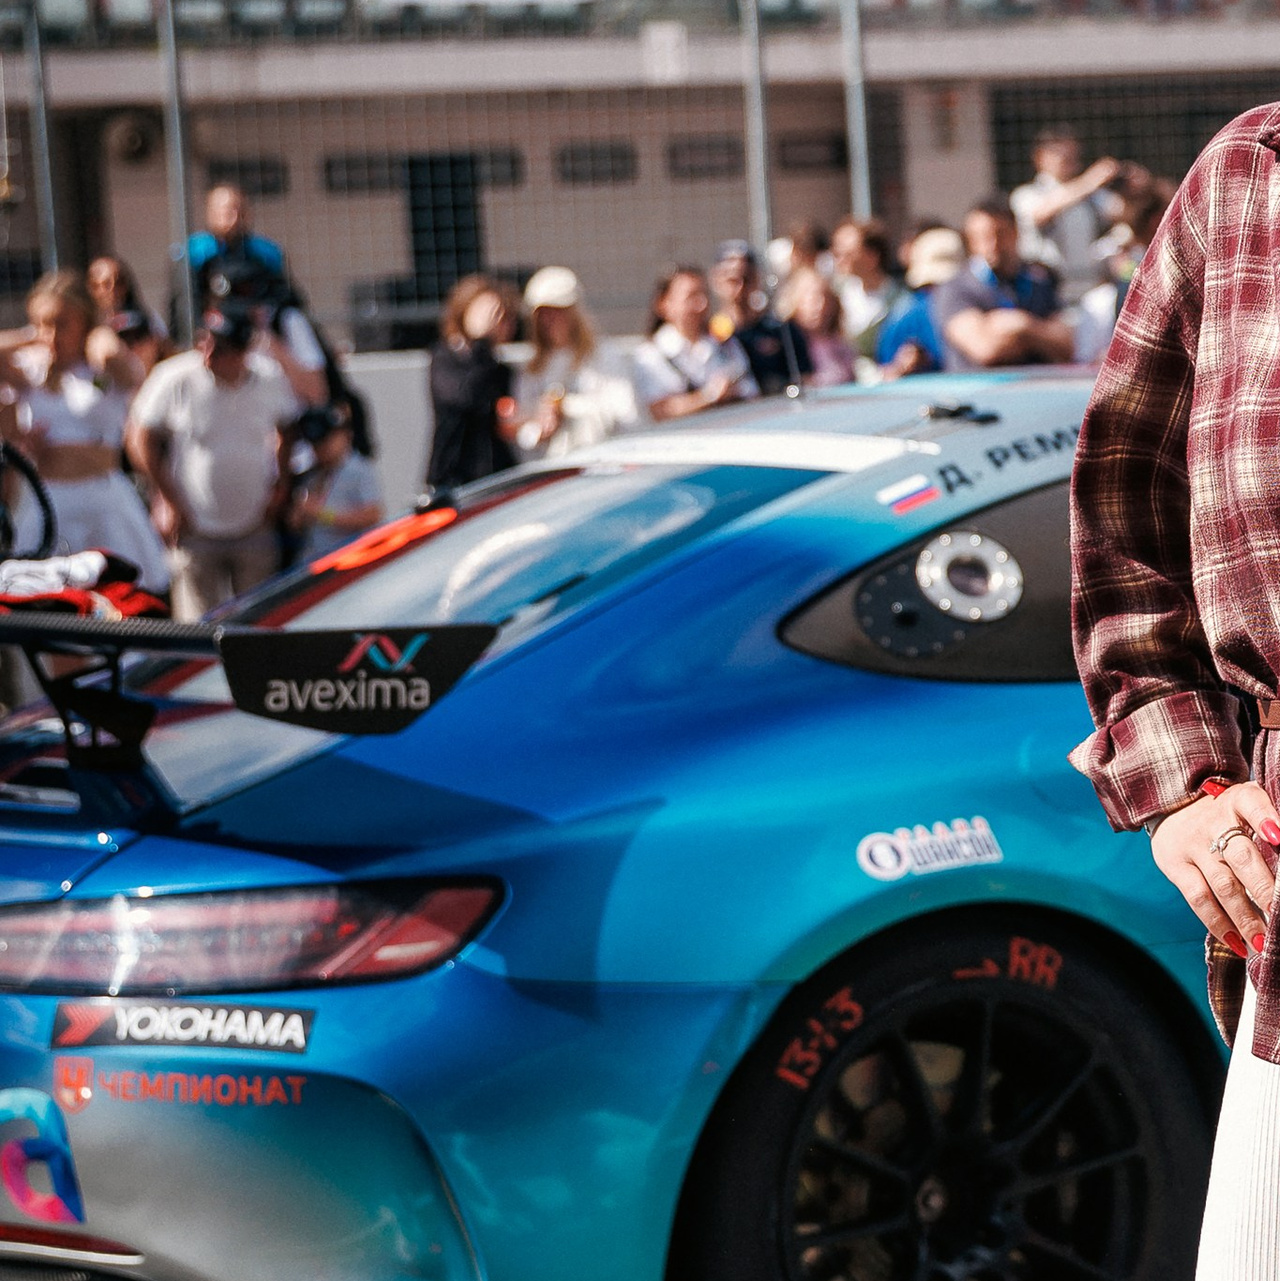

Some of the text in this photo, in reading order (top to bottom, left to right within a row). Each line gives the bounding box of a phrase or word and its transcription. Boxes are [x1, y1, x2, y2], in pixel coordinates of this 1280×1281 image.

[264, 669, 431, 712] avexima
[1008, 936, 1063, 990] RR
[115, 1006, 305, 1049] YOKOHAMA
[98, 1071, 307, 1106] ЧЕМПИОНАТ
